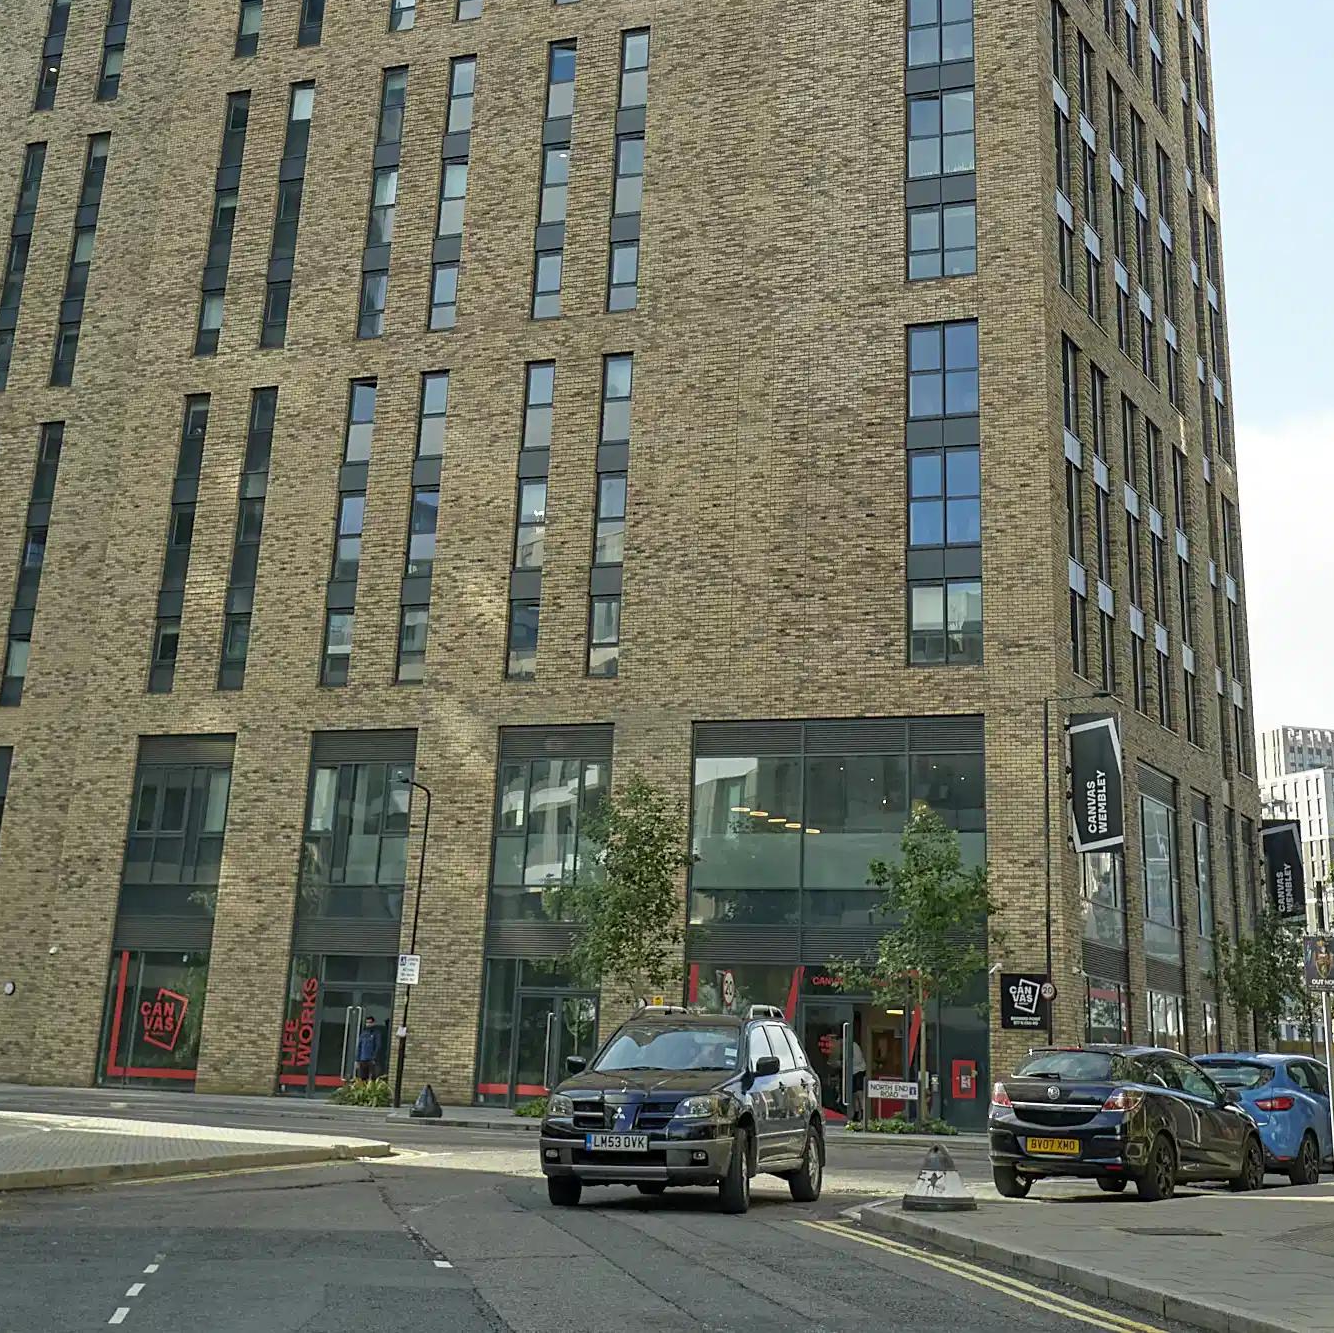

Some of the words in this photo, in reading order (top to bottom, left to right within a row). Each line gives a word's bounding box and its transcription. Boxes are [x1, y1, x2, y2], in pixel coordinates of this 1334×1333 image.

[1086, 780, 1098, 834] CANVAS
[1096, 770, 1108, 834] WEMBLEY
[1276, 872, 1286, 913] CANVAS
[1284, 863, 1294, 913] WEMBLEY
[1009, 985, 1033, 995] CAN
[1042, 986, 1054, 996] 20
[1012, 994, 1034, 1003] VAS
[140, 1001, 175, 1016] CAN
[144, 1016, 174, 1031] VAS
[296, 977, 318, 1067] WORKS
[281, 1018, 300, 1067] LIFE
[870, 1083, 893, 1092] NORTH
[880, 1090, 899, 1098] ROAD
[594, 1136, 621, 1148] LM53
[624, 1136, 645, 1148] OVK
